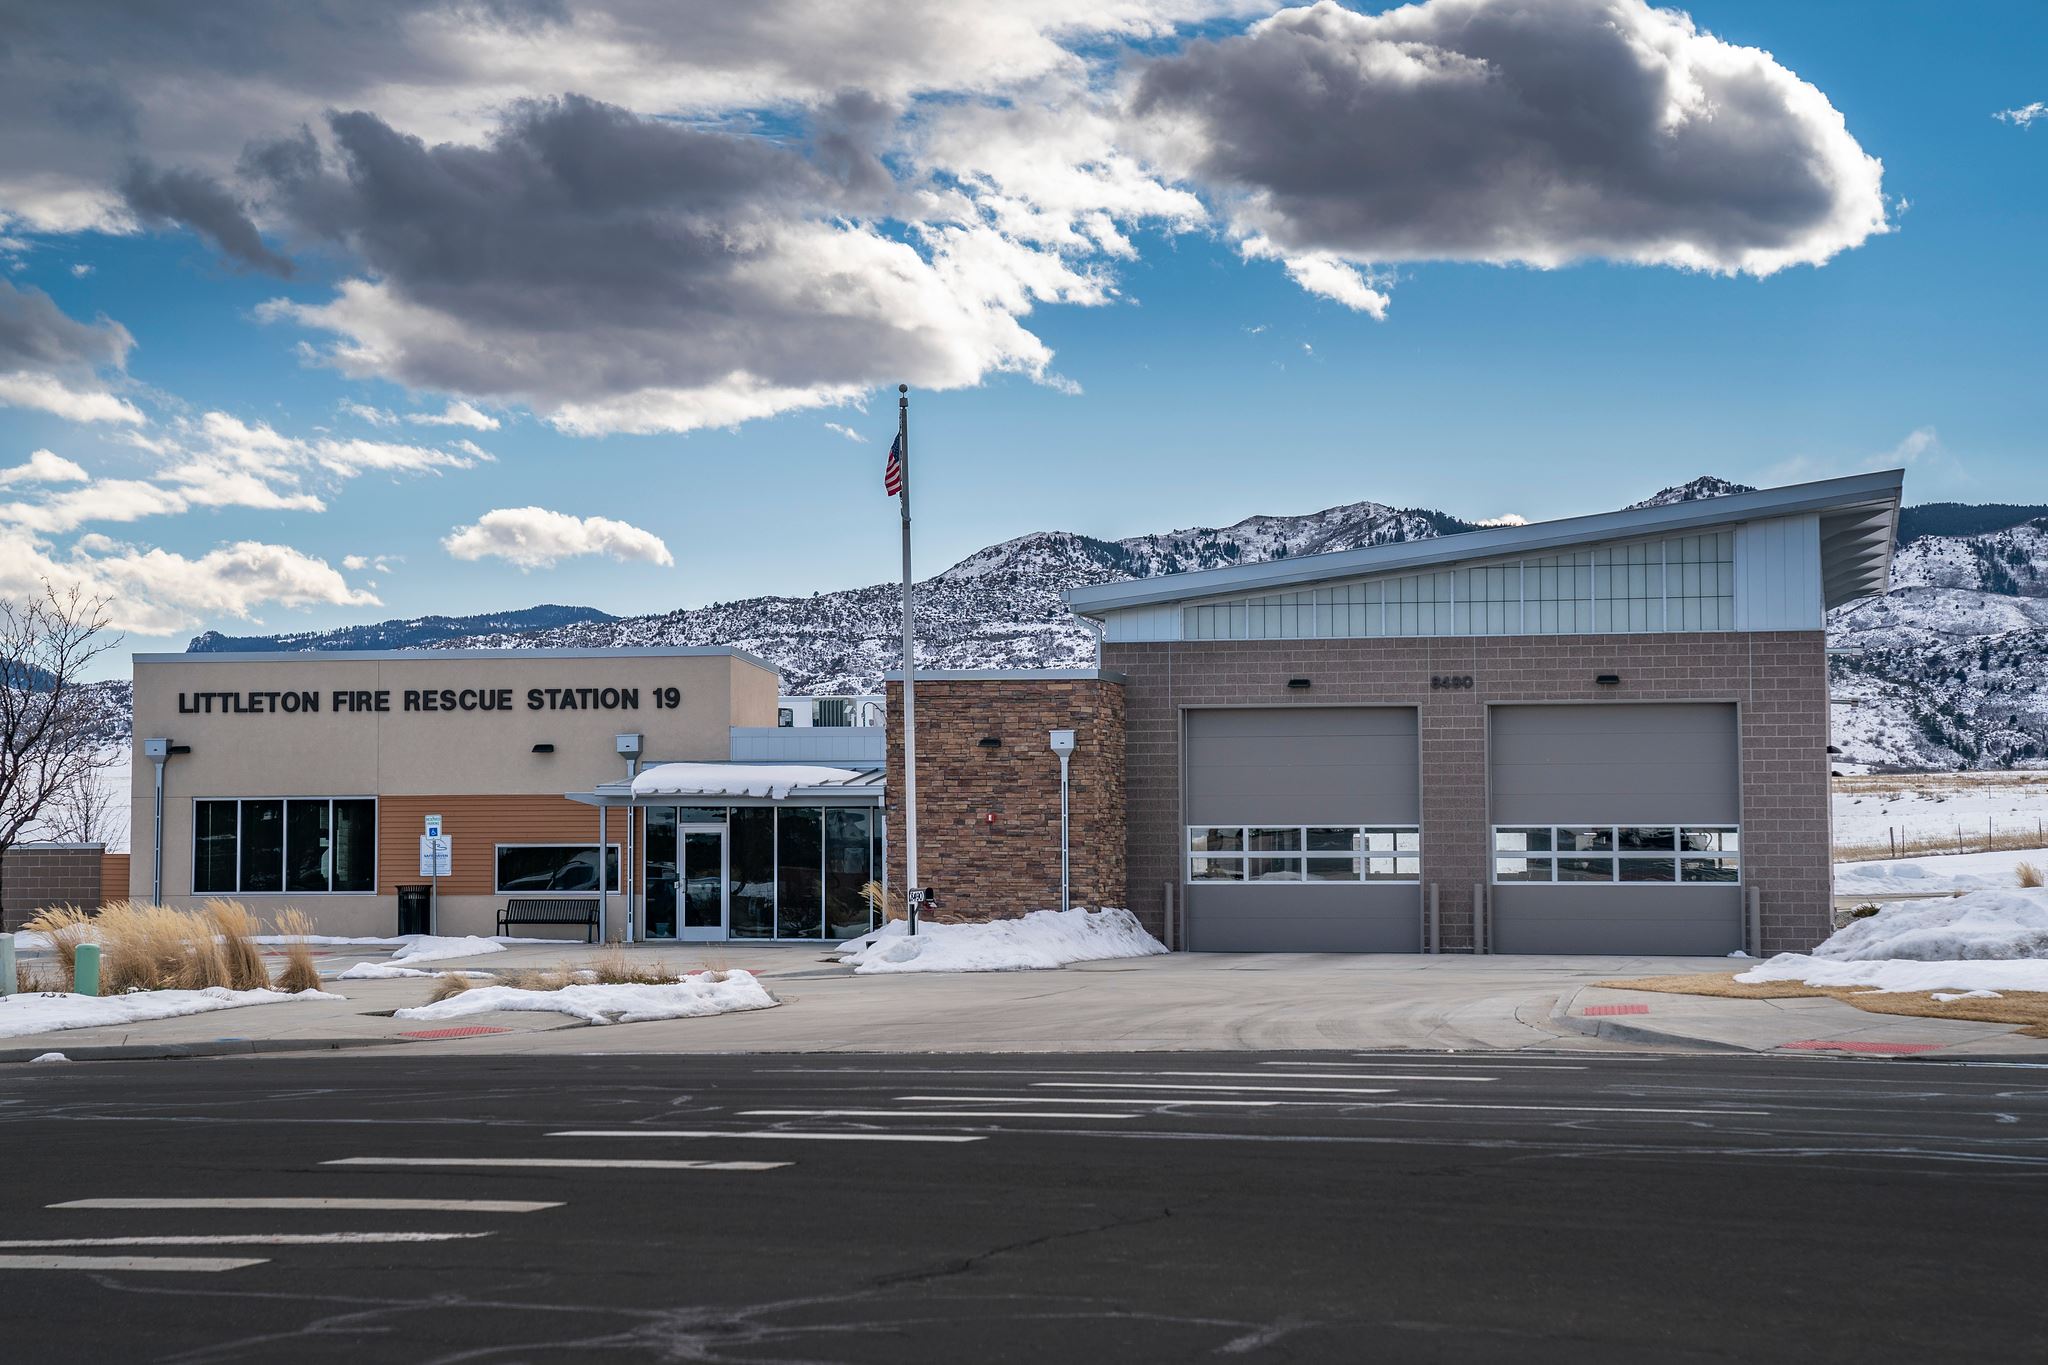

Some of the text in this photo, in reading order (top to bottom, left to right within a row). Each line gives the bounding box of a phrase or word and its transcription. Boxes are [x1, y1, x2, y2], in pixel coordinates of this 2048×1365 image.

[178, 687, 681, 713] LITTLETON FIRE RESCUE STATION 19
